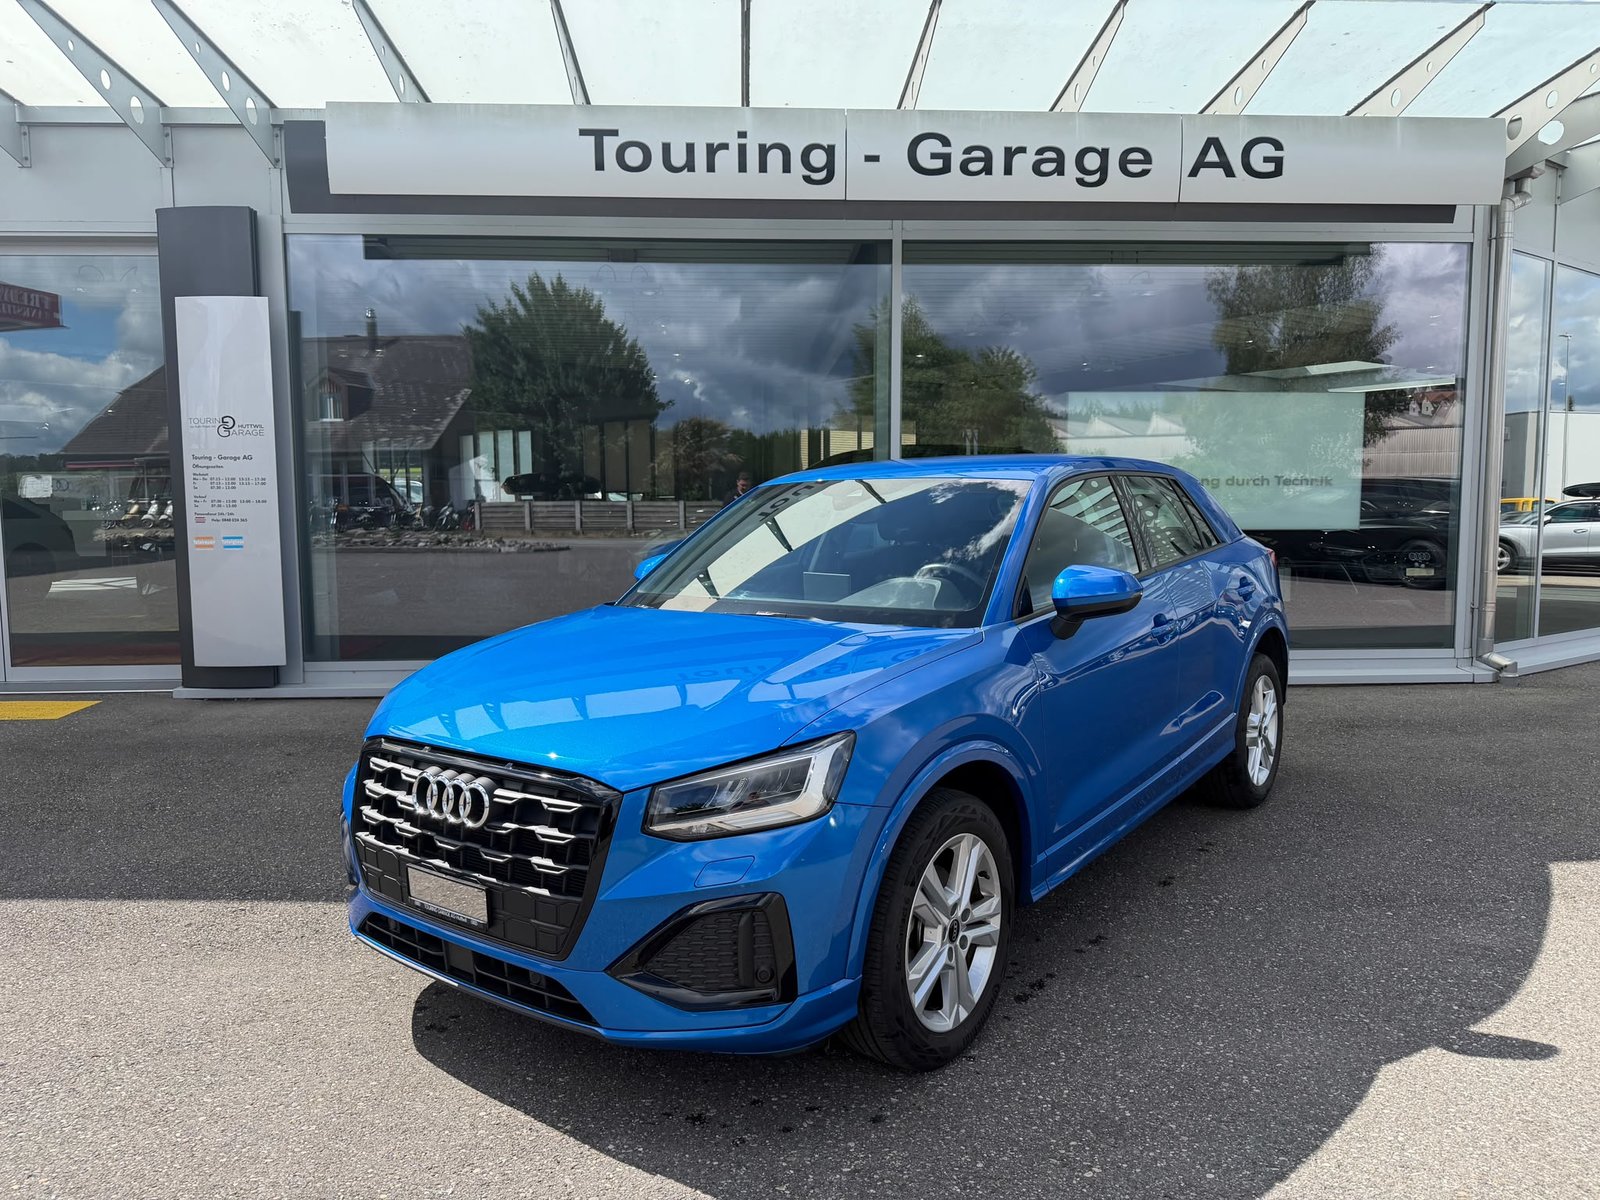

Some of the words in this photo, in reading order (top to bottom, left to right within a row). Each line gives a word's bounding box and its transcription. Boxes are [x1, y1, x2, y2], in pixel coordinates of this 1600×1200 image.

[579, 127, 837, 186] Touring
[863, 154, 880, 163] -
[906, 132, 1154, 188] Garage
[1187, 137, 1284, 179] AG
[217, 424, 264, 437] GARAGE
[192, 454, 212, 462] Touring
[1225, 475, 1270, 486] durch
[1274, 475, 1333, 487] Technik
